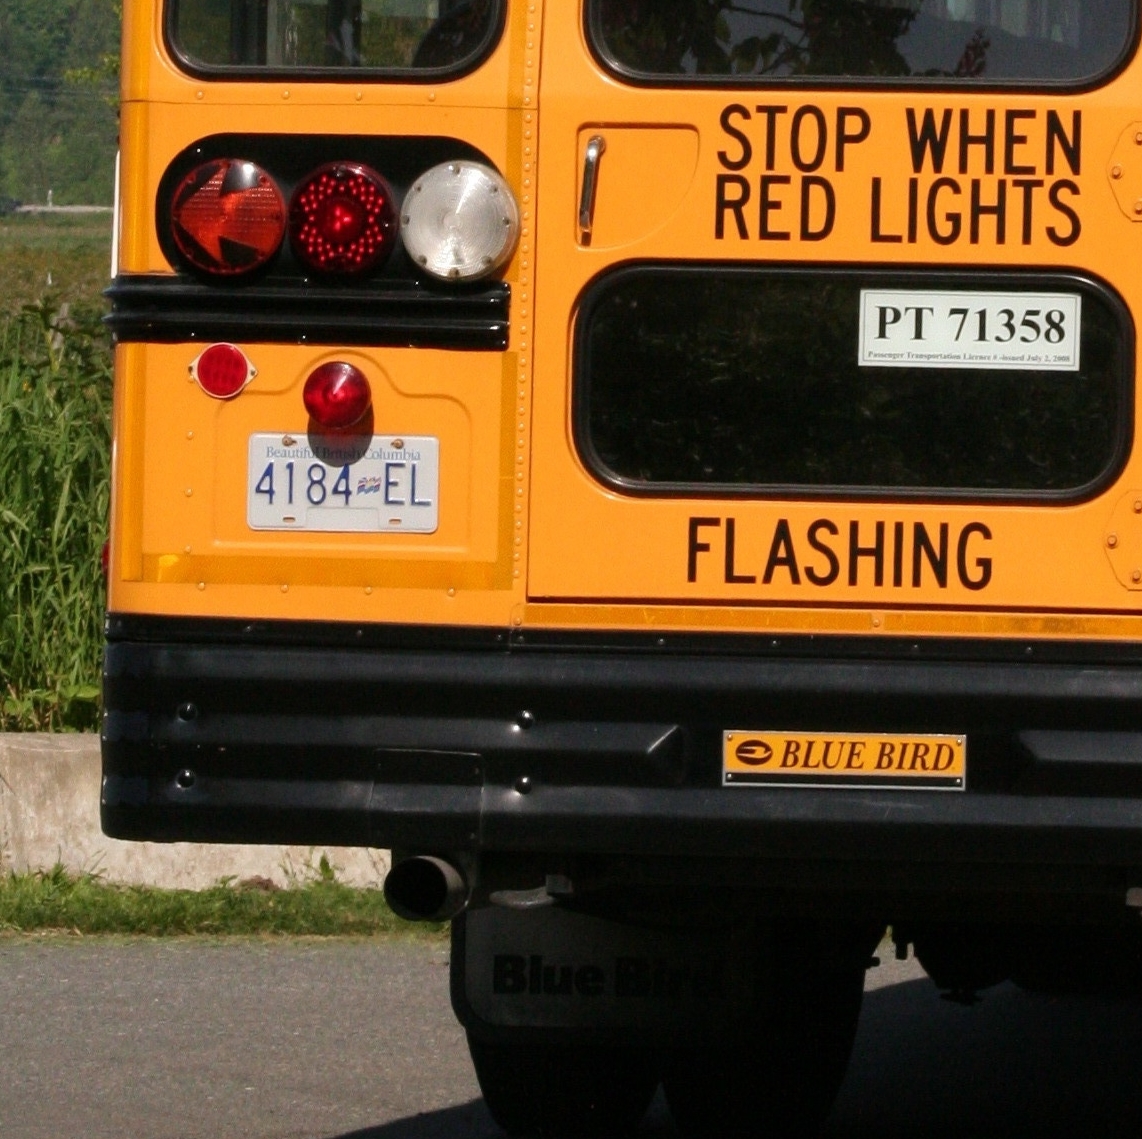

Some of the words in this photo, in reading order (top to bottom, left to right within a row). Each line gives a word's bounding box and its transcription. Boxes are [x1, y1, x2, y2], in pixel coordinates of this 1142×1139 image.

[717, 103, 871, 172] STOP
[905, 107, 1082, 175] WHEN
[714, 174, 836, 241] RED
[871, 177, 1082, 246] LIGHTS
[874, 306, 934, 340] PT
[947, 308, 1066, 343] 71358
[868, 350, 904, 359] Passenger
[266, 445, 318, 458] Beautiful
[363, 447, 421, 460] Columbia
[255, 462, 352, 505] 4184
[384, 462, 431, 506] EL
[687, 517, 993, 590] FLASHING
[779, 740, 866, 769] BLUE
[874, 742, 955, 771] BIRD
[493, 954, 604, 995] Blue
